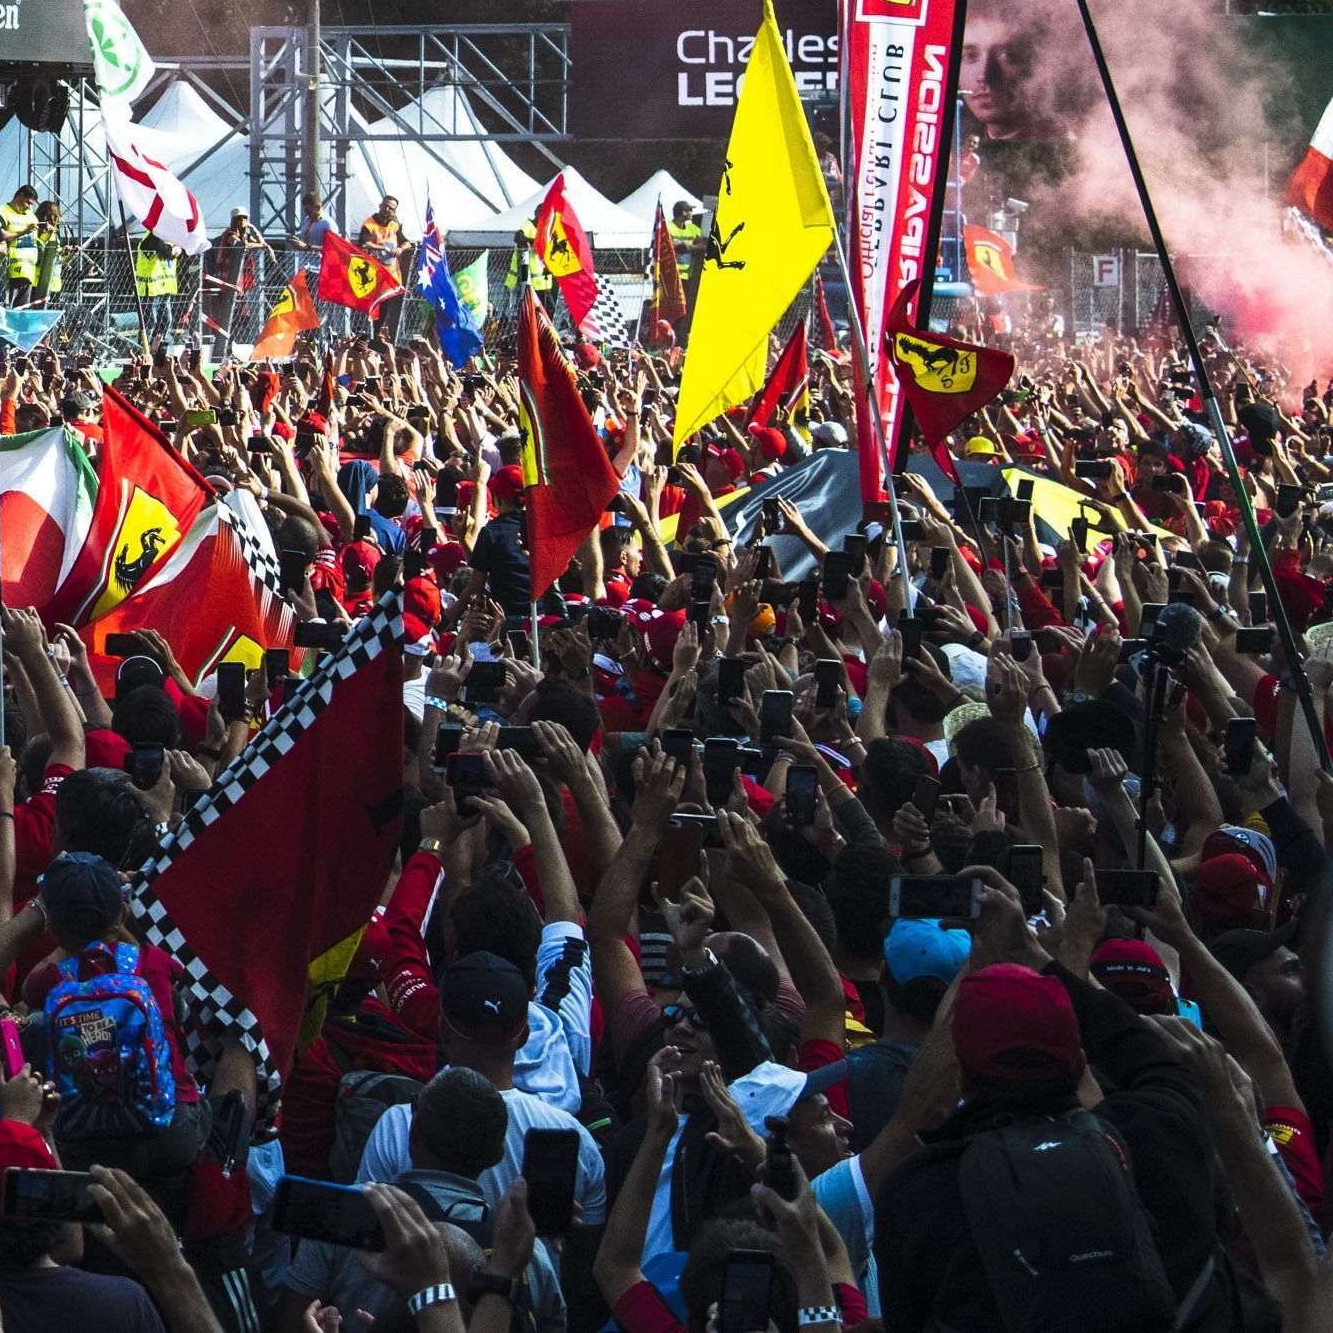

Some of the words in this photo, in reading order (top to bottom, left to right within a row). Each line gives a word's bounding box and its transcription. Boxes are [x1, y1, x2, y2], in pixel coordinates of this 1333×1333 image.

[1098, 260, 1113, 283] F
[60, 1015, 76, 1027] IT'S
[77, 1009, 101, 1023] TIME
[82, 1022, 95, 1032] TO
[81, 1030, 112, 1047] HERO!
